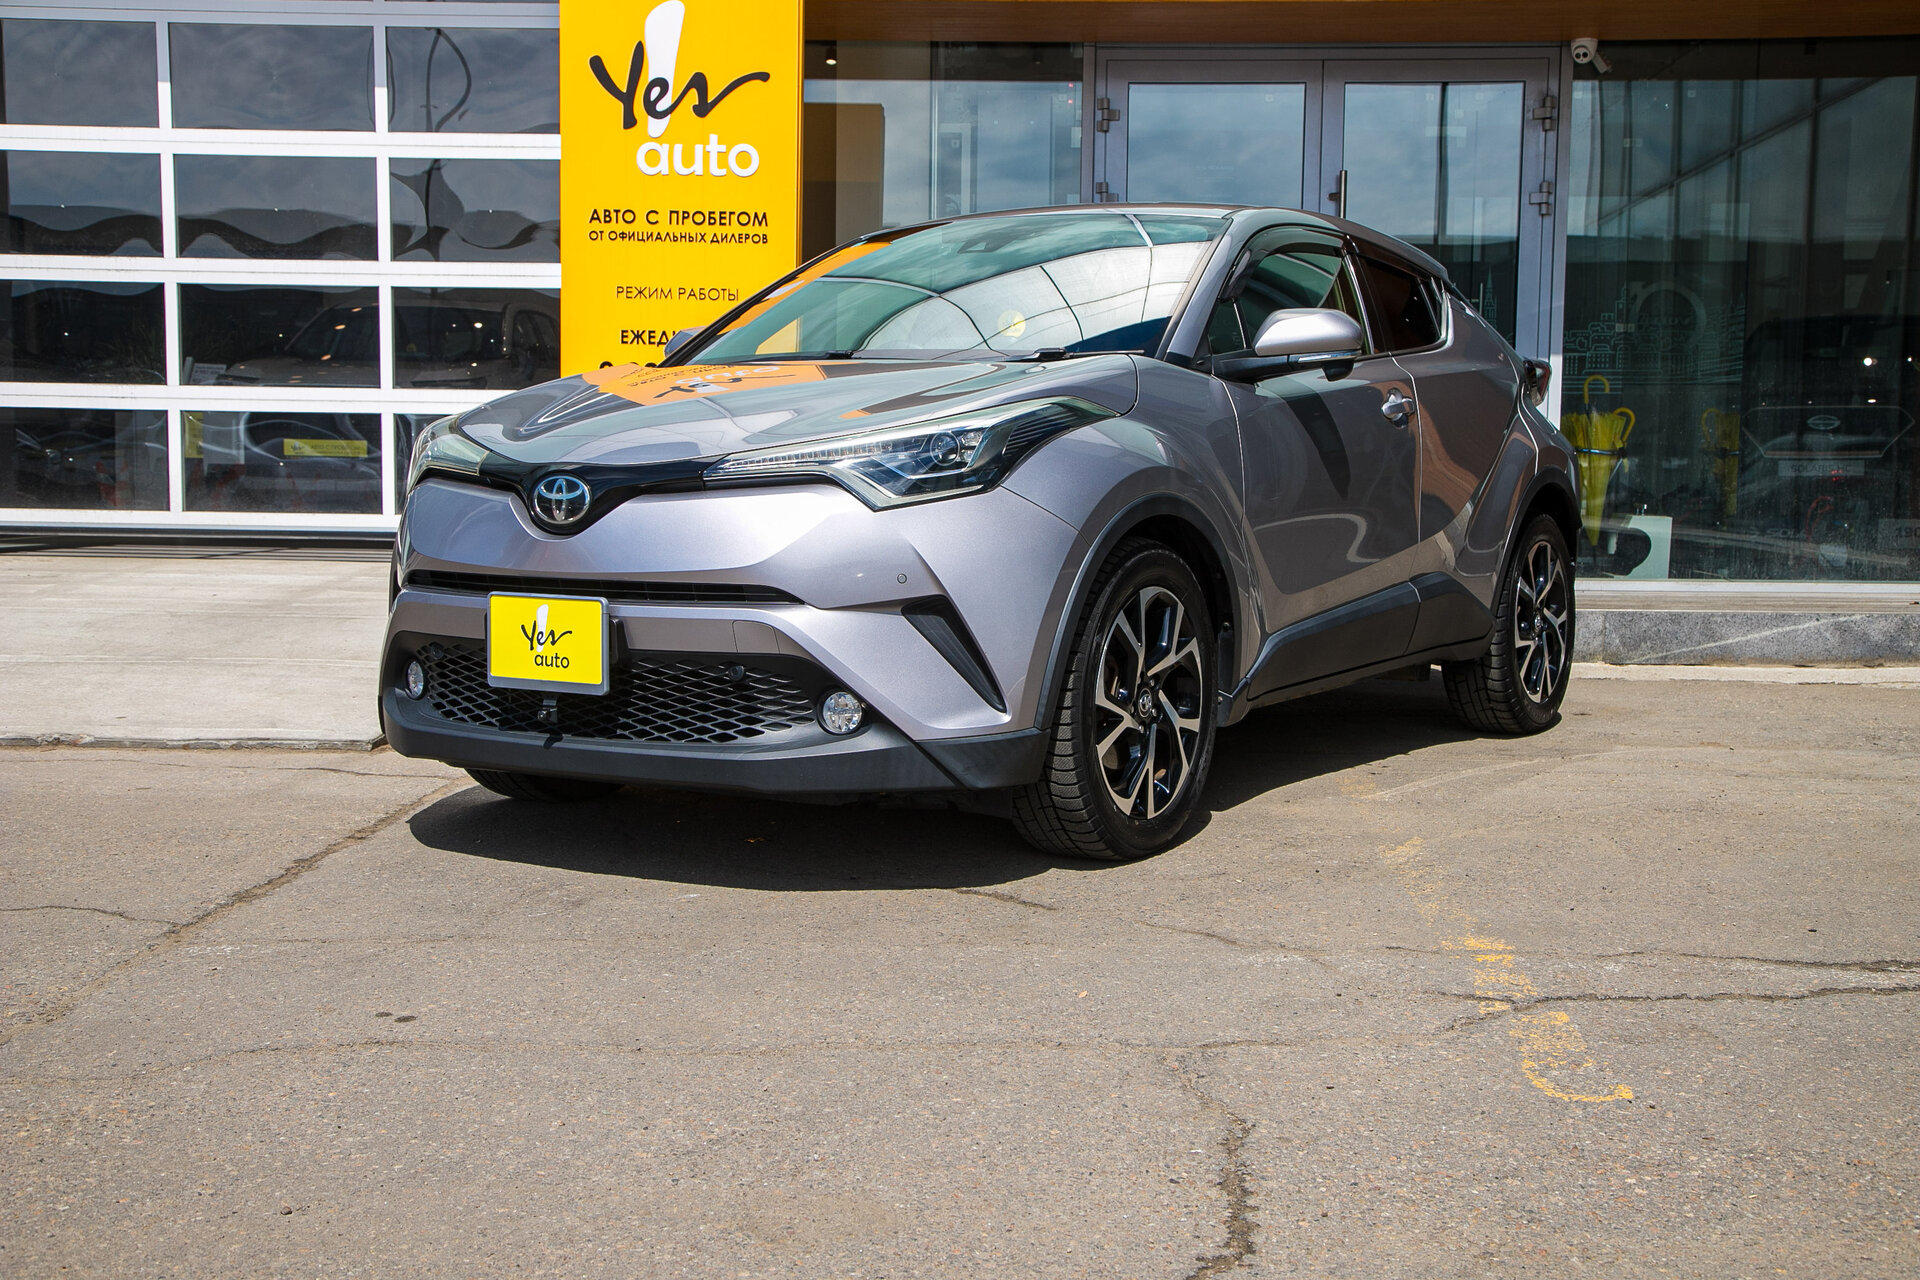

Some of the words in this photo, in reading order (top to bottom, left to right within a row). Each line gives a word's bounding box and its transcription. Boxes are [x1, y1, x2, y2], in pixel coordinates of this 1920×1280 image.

[589, 40, 771, 130] Yes
[636, 134, 760, 177] auto
[589, 209, 636, 224] АВТО
[645, 210, 659, 225] С
[669, 210, 768, 227] ПРОБЕГОМ
[588, 230, 604, 241] ОТ
[608, 231, 706, 243] ОФИЦИАЛЬНЫХ
[710, 233, 768, 244] ДИЛЕРОВ
[616, 286, 672, 300] РЕЖИМ
[678, 287, 739, 301] РАБОТЫ
[620, 330, 676, 347] ЕЖЕД
[520, 620, 572, 651] Yes
[534, 652, 569, 668] auto
